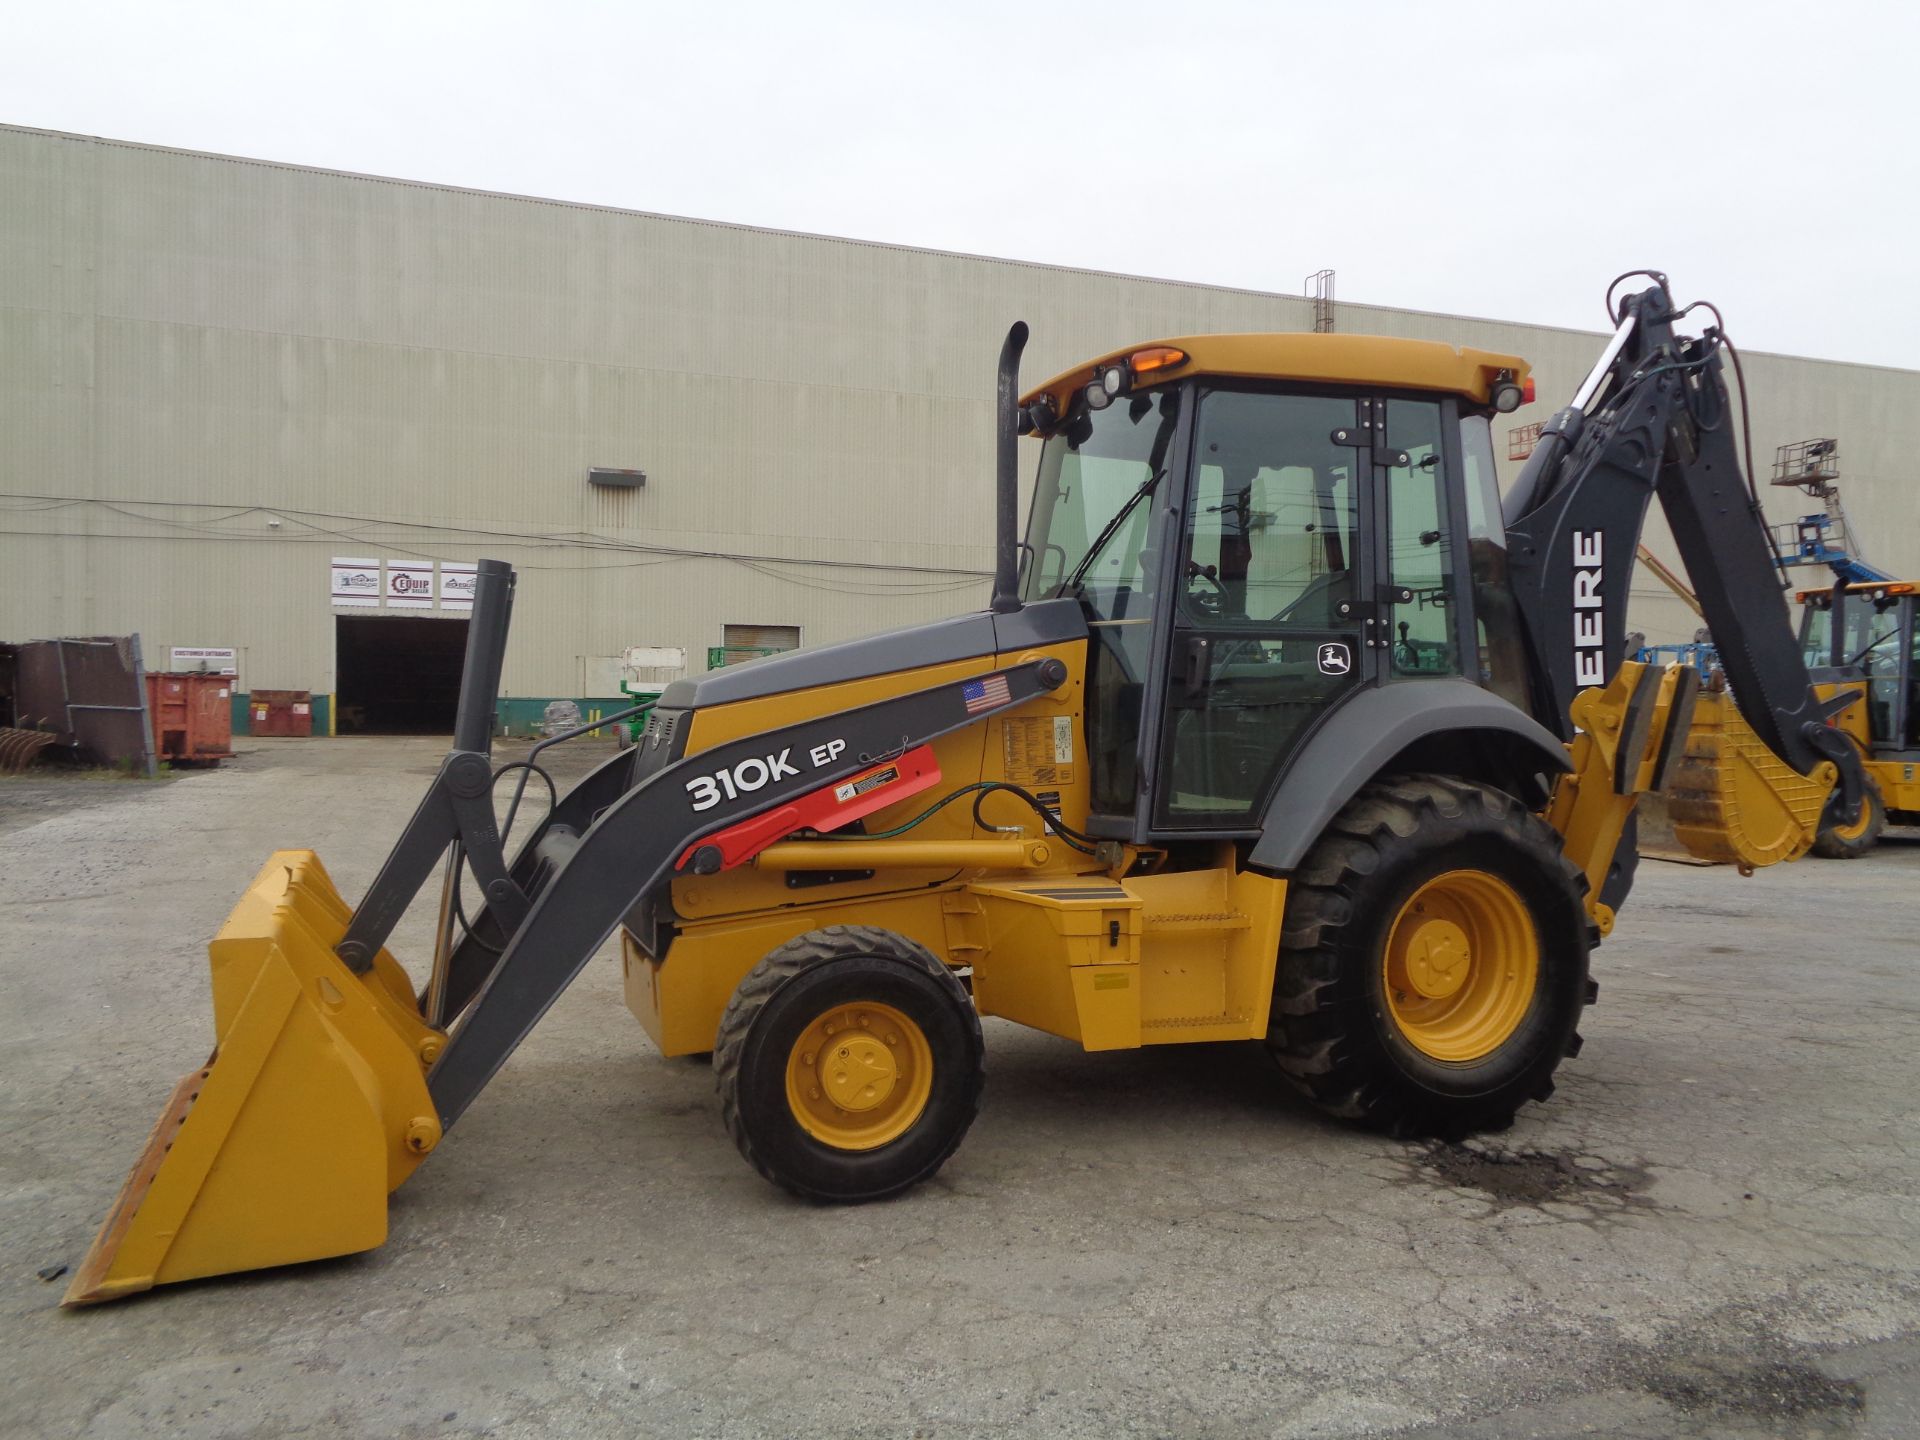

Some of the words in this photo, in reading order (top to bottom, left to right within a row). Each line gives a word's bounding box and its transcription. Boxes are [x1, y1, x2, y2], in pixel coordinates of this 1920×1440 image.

[400, 579, 429, 588] EQUIP
[1573, 531, 1604, 734] EERE
[686, 748, 800, 811] 310K
[809, 738, 846, 767] EP
